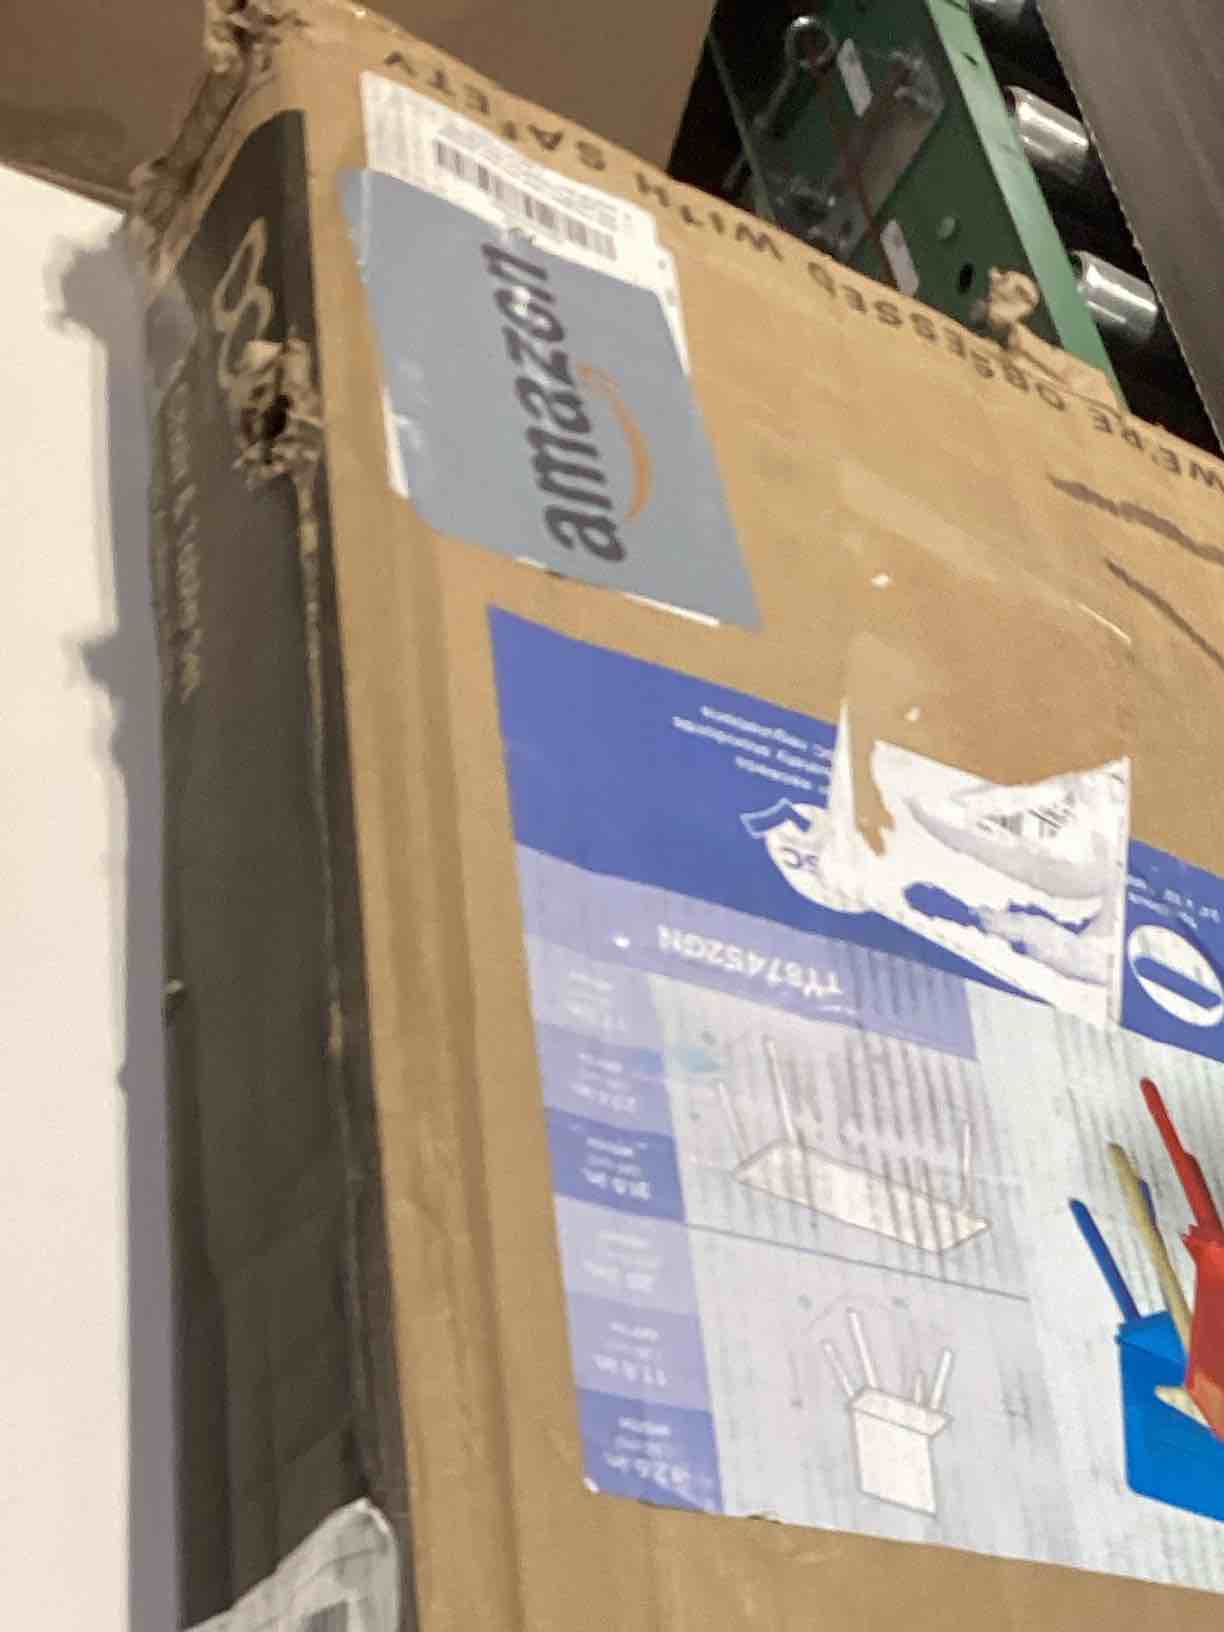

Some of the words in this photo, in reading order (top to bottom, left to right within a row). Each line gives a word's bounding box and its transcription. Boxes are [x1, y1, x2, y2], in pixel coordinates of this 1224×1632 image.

[632, 172, 784, 263] WITH
[481, 241, 626, 564] amazon
[805, 260, 1070, 413] OBSESSED
